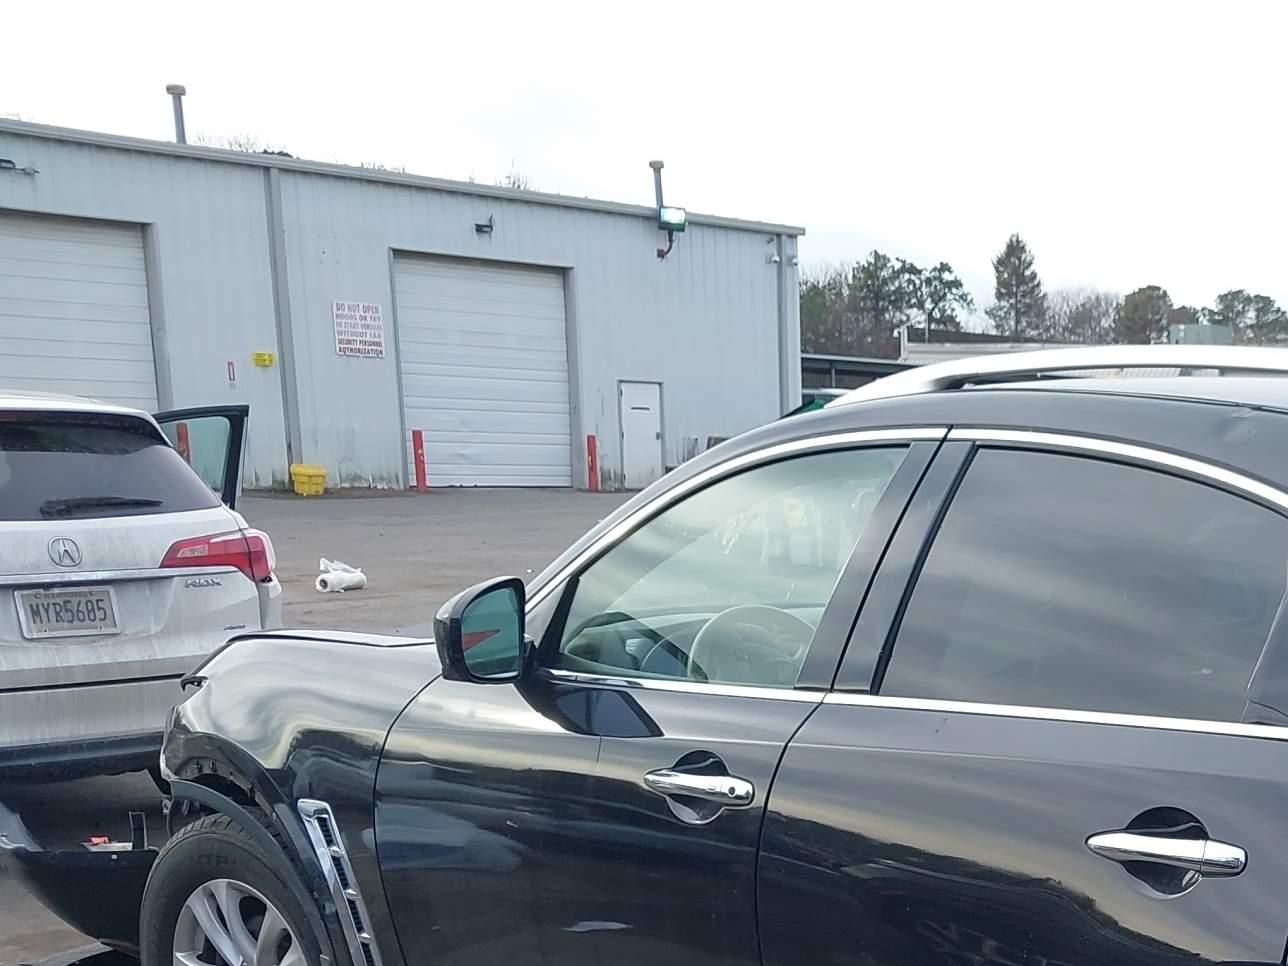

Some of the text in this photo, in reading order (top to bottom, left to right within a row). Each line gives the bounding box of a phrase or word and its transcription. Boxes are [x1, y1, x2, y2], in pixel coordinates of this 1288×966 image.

[335, 302, 380, 315] DO NOT OPEN
[335, 313, 357, 321] HOODS
[359, 314, 368, 322] OR
[344, 321, 359, 330] START
[336, 330, 368, 338] WITHOUT
[337, 338, 383, 348] SECURITY PERSONNEL
[338, 346, 384, 356] AUTHORIZATION
